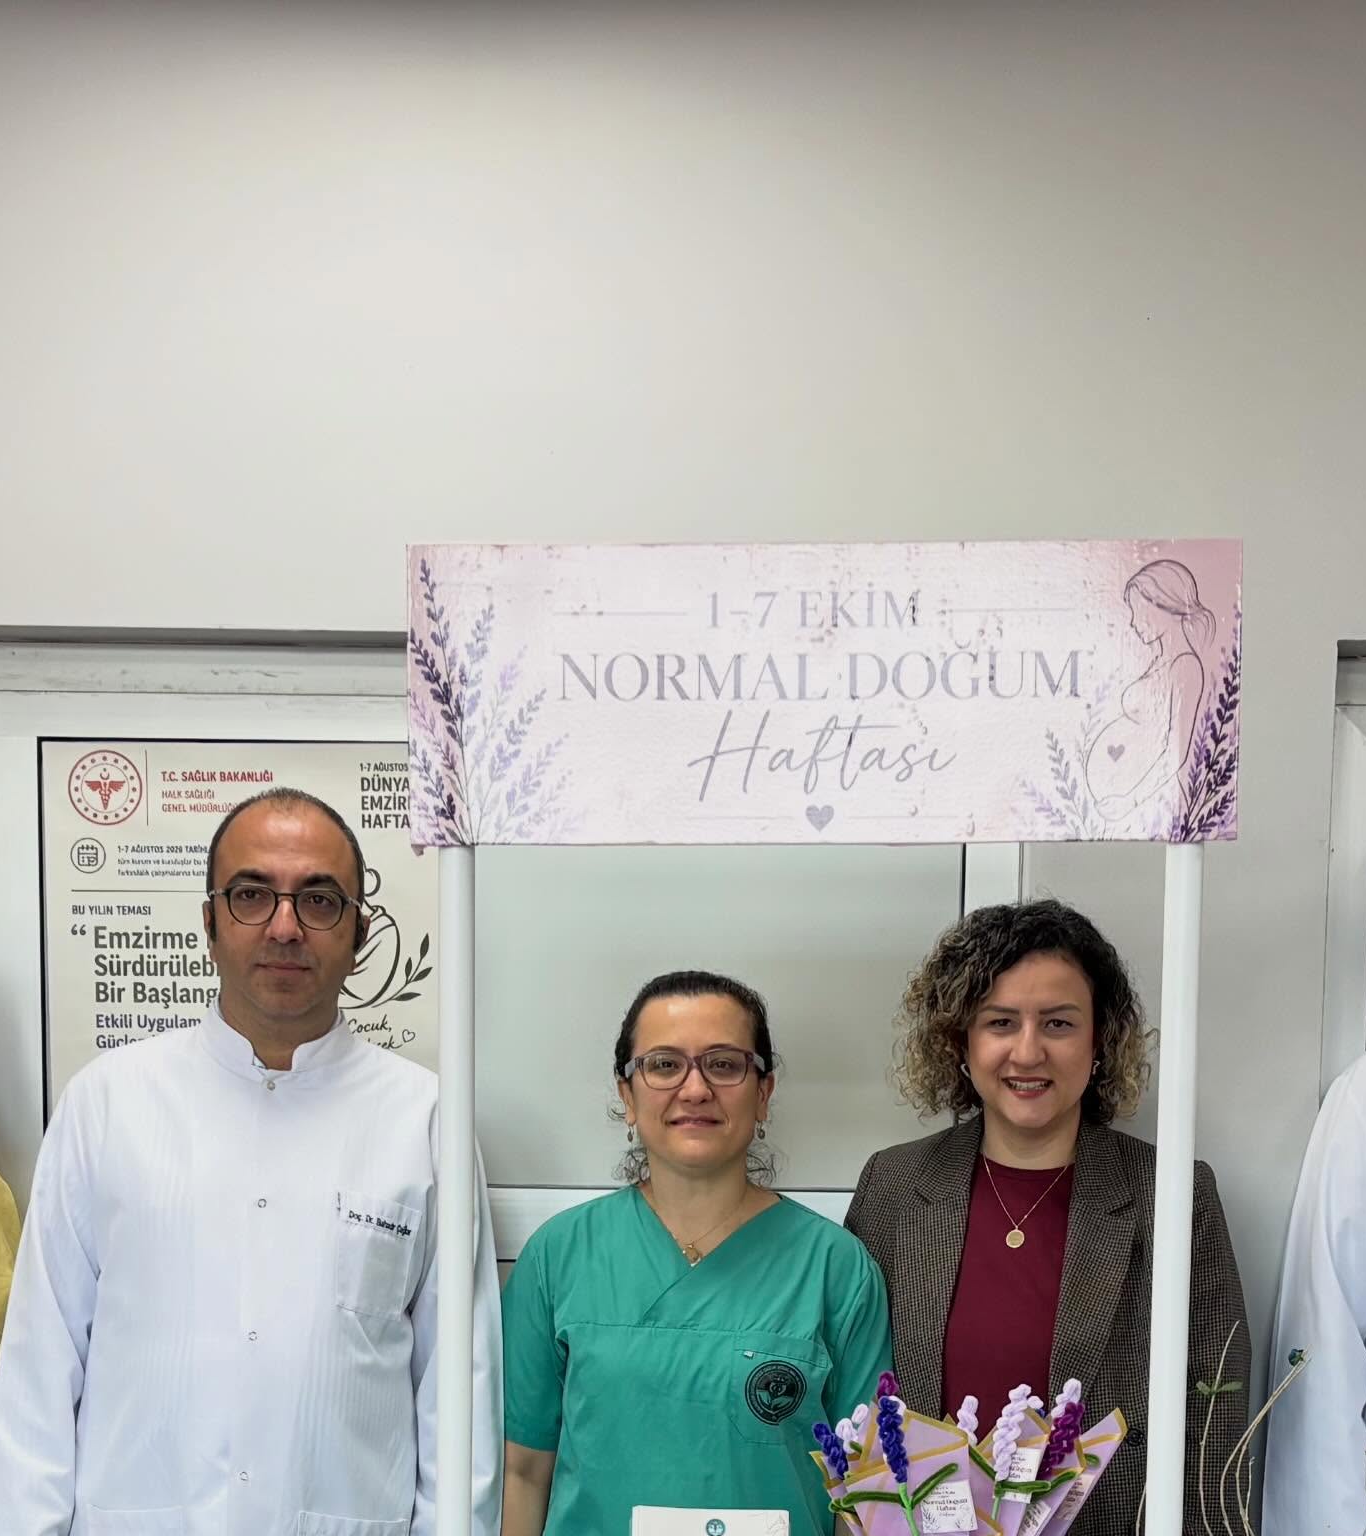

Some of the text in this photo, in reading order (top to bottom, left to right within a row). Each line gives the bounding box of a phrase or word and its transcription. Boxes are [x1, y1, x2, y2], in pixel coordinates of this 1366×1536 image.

[798, 582, 923, 629] EKİM
[557, 639, 1086, 701] NORMAL DOĞUM
[687, 709, 956, 802] Haftası
[161, 769, 274, 783] T.C. SAĞLIK BAKANLIĞI
[373, 761, 409, 772] AĞUSTOS
[361, 774, 410, 792] DÜNYA
[162, 788, 215, 800] HALK SAĞLIĞI
[361, 792, 410, 811] EMZİR
[162, 803, 187, 813] GENEL
[362, 813, 411, 829] HAFTA
[72, 904, 152, 916] BU YILIN TEMASI
[94, 925, 199, 949] Emzirme
[94, 953, 220, 977] Sürdürüleb
[95, 981, 218, 1008] Bir Başlang
[96, 1013, 201, 1032] Etkili Uygulam
